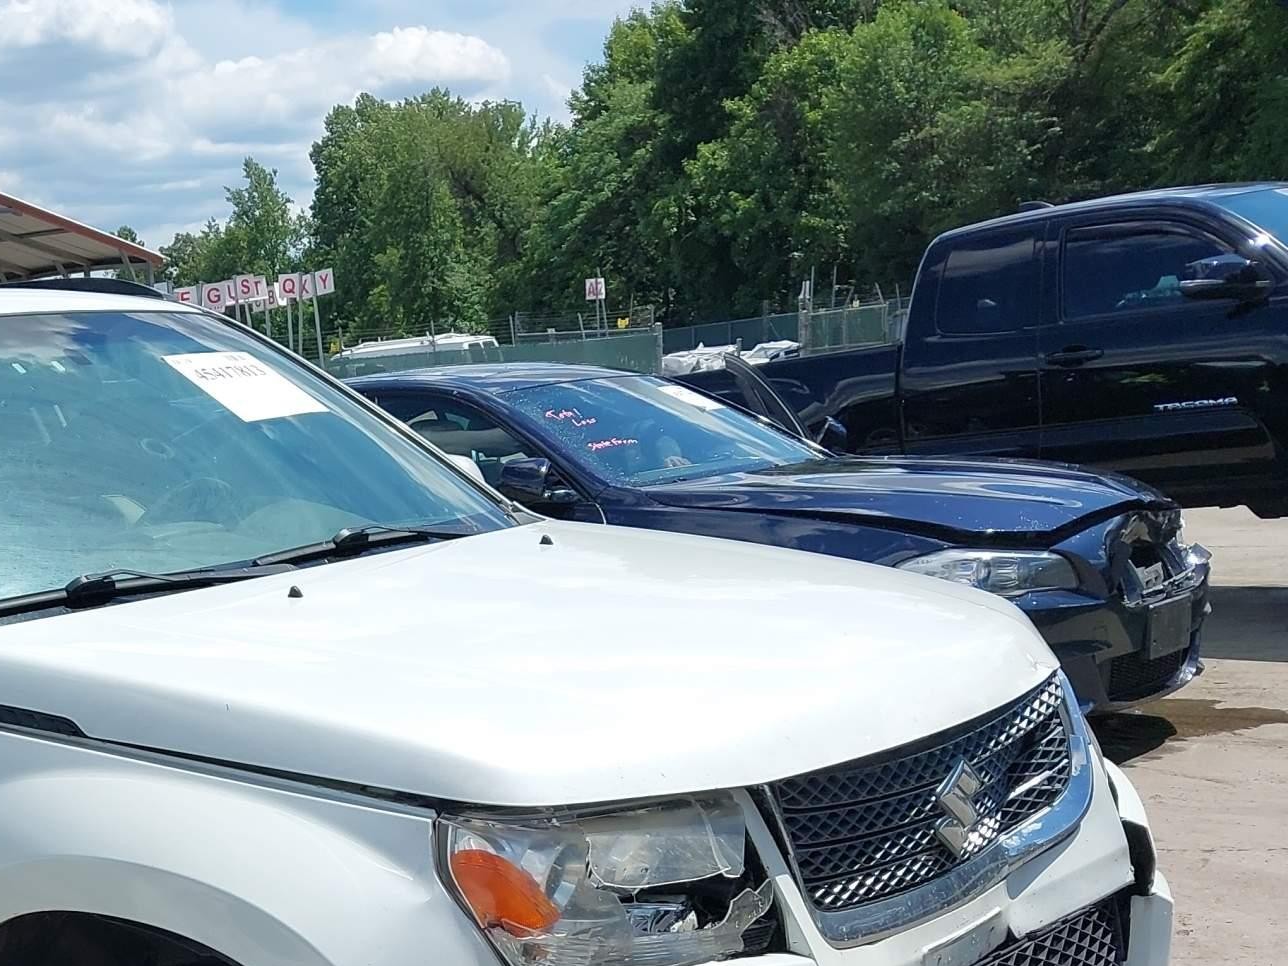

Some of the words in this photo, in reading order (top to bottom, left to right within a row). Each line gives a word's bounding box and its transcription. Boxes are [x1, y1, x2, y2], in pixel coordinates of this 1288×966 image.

[242, 279, 250, 294] S
[283, 279, 295, 294] Q
[319, 274, 328, 289] Y
[207, 288, 220, 303] G
[268, 290, 275, 304] B
[1153, 396, 1238, 411] TACOMA
